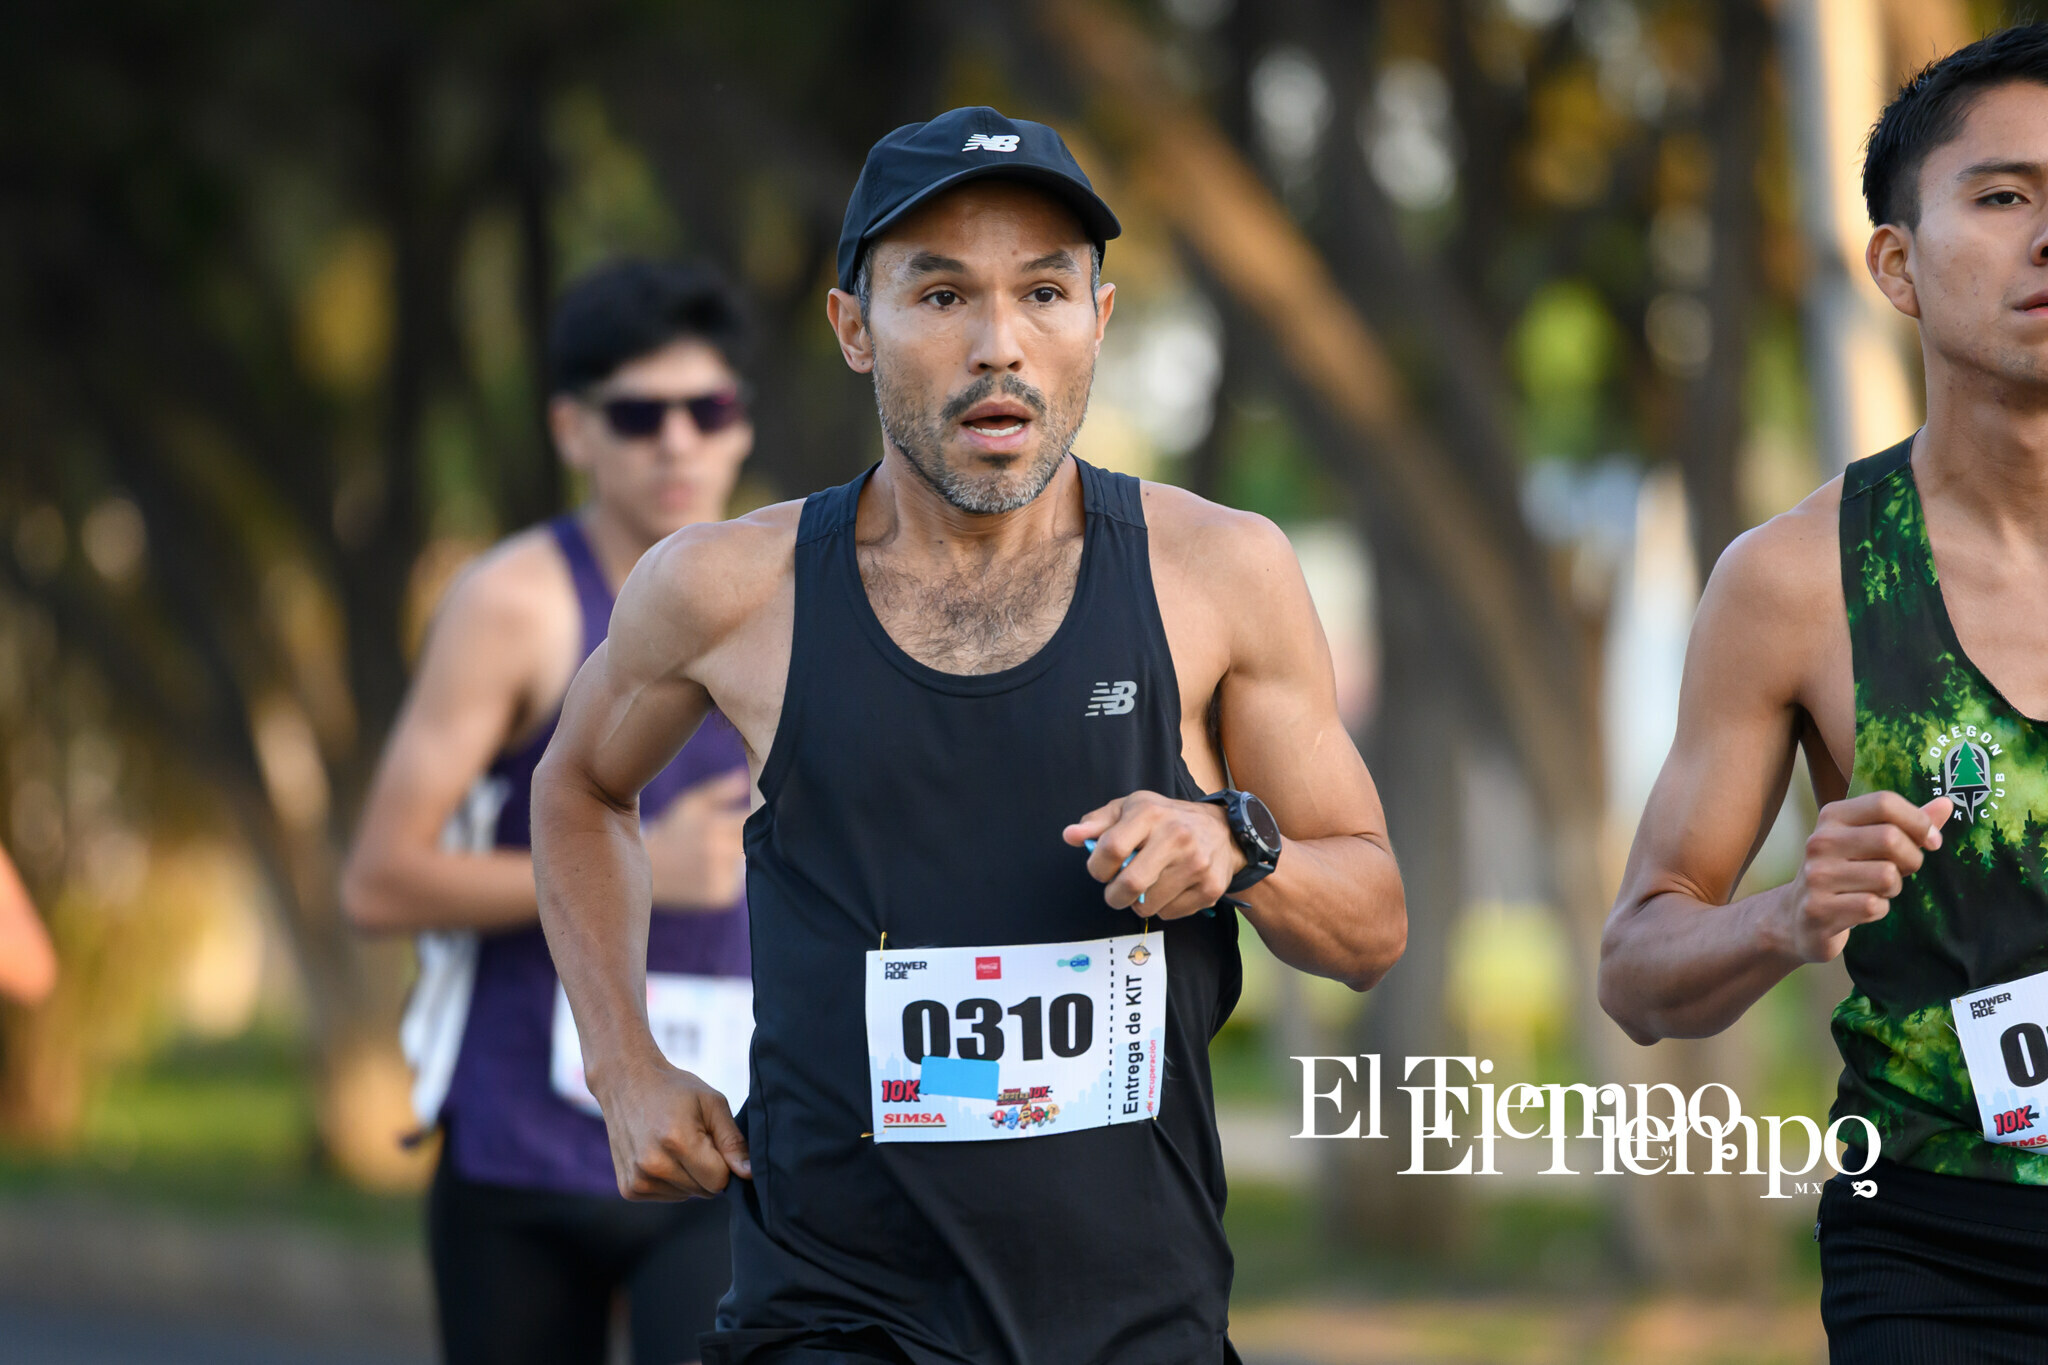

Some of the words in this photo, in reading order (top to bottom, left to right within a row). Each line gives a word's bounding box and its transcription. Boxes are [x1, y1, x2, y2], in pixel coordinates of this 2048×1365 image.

[1929, 725, 2003, 758] OREGON
[1931, 774, 1963, 821] TRK
[885, 961, 928, 970] POWER
[1126, 975, 1143, 1007] KIT
[1969, 992, 2013, 1012] POWER
[902, 992, 1094, 1066] 0310
[1125, 1012, 1141, 1035] de
[882, 1079, 921, 1103] 10K
[1123, 1040, 1144, 1115] Entrega
[883, 1113, 946, 1125] SIMSA
[1993, 1105, 2035, 1137] 10K
